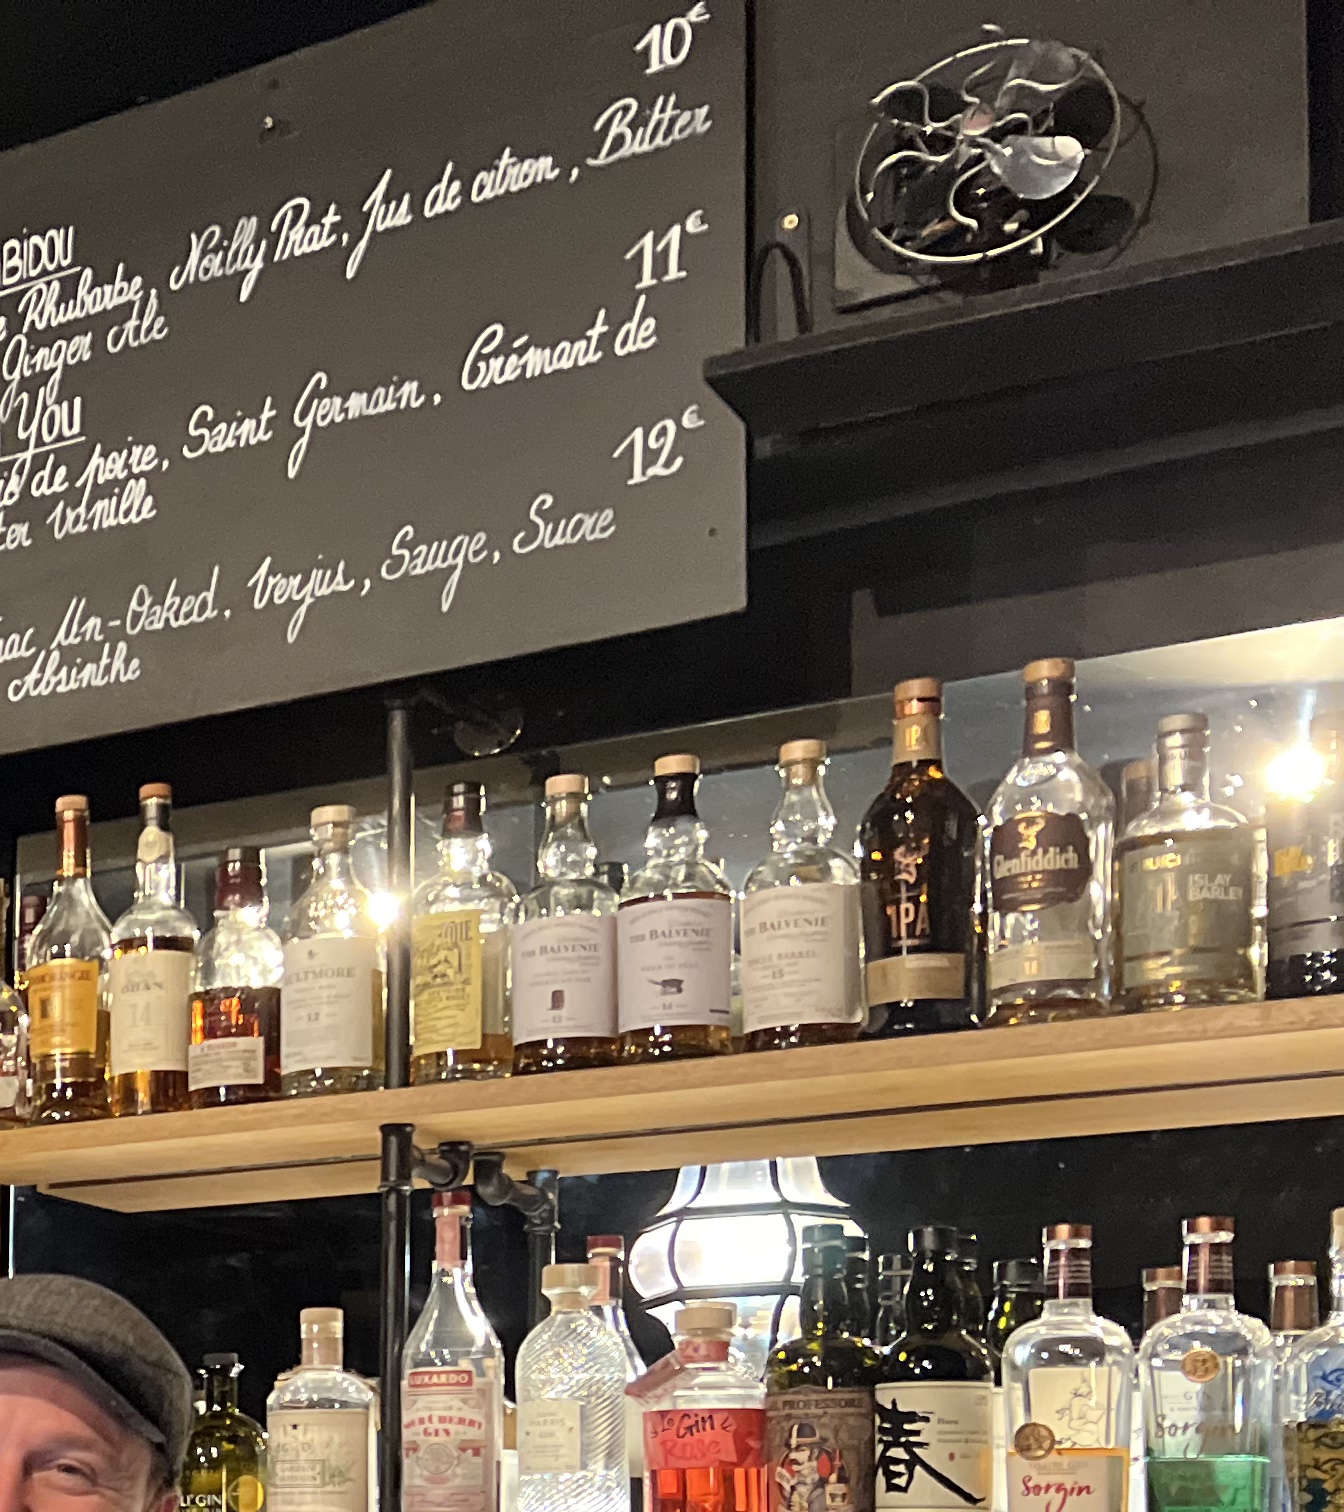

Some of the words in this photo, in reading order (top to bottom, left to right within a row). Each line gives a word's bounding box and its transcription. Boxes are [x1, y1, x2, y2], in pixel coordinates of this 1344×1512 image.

[18, 262, 156, 333] Rhubarbe,
[170, 216, 267, 302] Noilly
[270, 197, 347, 263] Prat,
[424, 161, 462, 219] de
[585, 92, 713, 167] Bitter
[0, 332, 92, 423] Ginger
[107, 289, 169, 354] Ale
[31, 454, 69, 499] de
[75, 437, 169, 508] poire,
[182, 396, 277, 459] Saint
[288, 372, 441, 479] Germain,
[461, 308, 609, 392] Crémant
[614, 294, 657, 356] de
[14, 392, 82, 495] YOU
[46, 478, 157, 540] Vanille
[247, 555, 371, 642] Verjus,
[380, 524, 500, 613] Sauge,
[513, 493, 615, 554] Sucre
[8, 640, 141, 702] Absinthe
[1188, 873, 1233, 888] ISLAY
[1188, 885, 1245, 901] BARLEY
[409, 1373, 470, 1387] LUXARDO
[877, 1397, 987, 1506] 春
